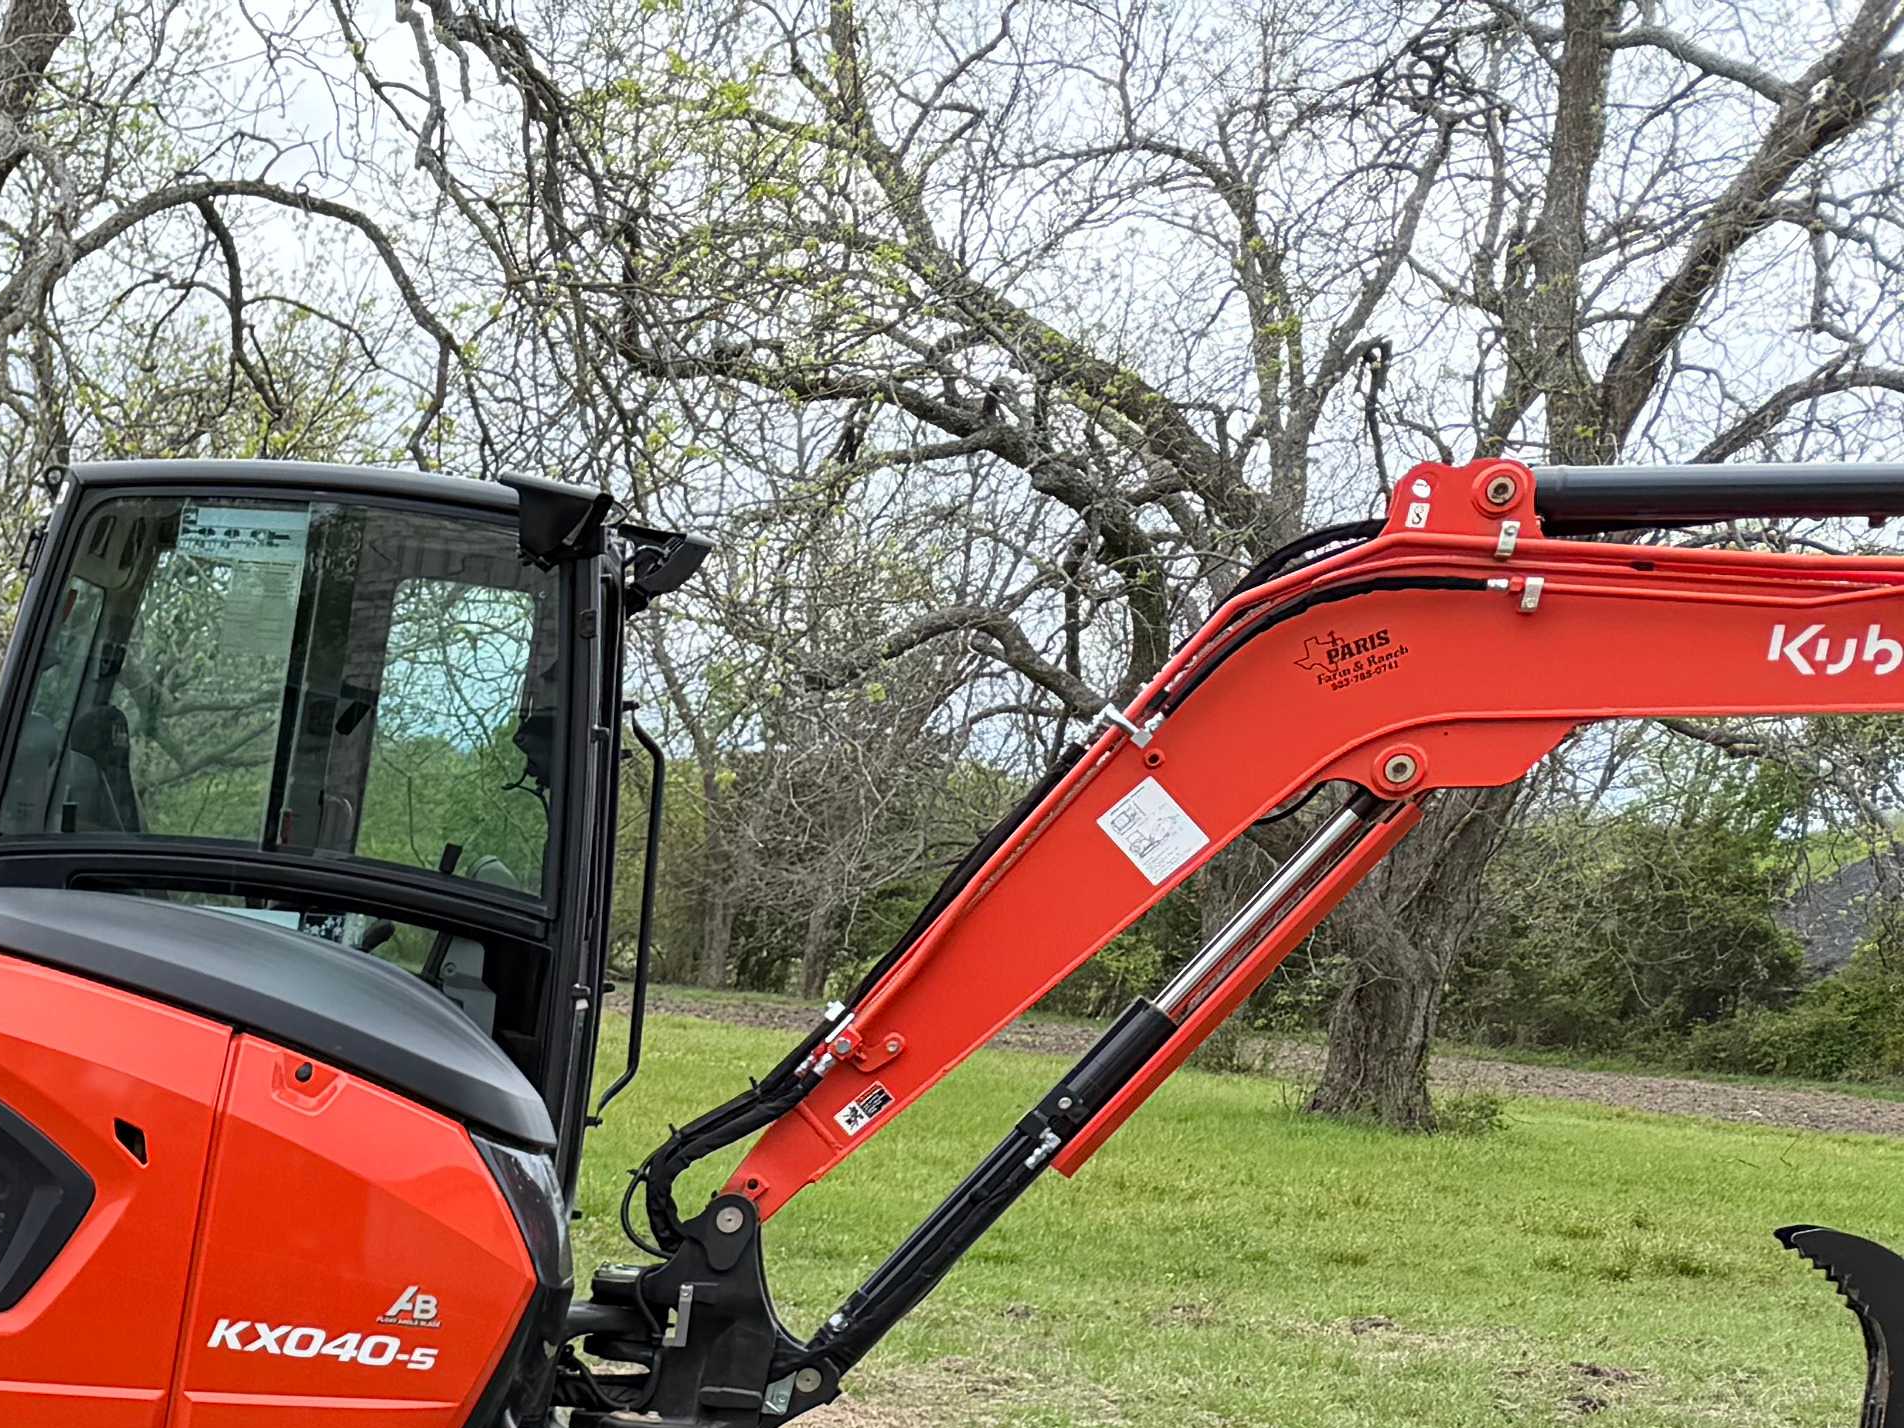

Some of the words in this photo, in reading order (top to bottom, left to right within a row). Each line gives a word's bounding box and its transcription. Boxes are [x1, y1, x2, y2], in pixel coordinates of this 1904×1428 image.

[1317, 668, 1351, 685] Farm
[1353, 660, 1364, 673] &
[1367, 644, 1409, 667] Ranch
[1326, 629, 1391, 665] PARIS
[207, 1319, 439, 1370] KX040-5
